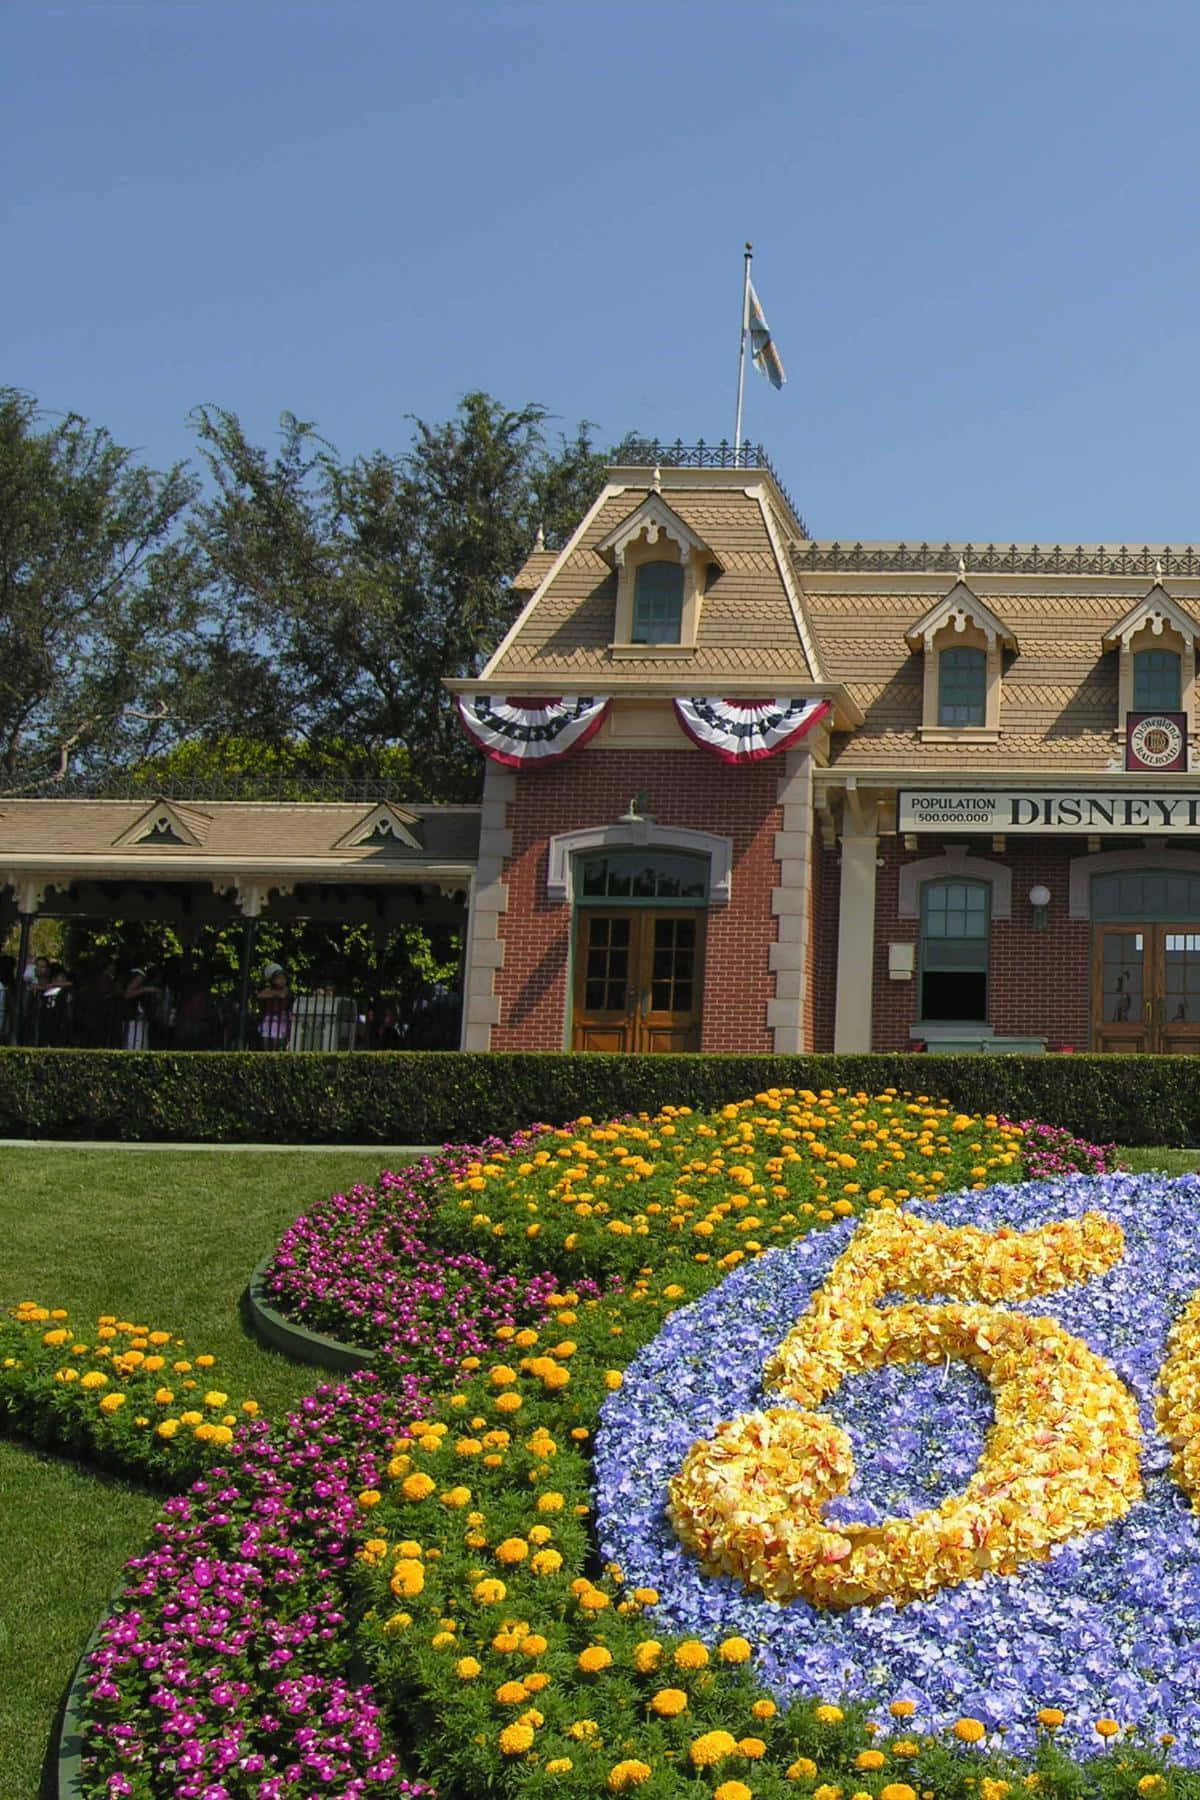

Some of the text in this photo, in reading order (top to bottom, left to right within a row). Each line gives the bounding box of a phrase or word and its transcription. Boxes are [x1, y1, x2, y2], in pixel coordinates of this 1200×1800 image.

[1134, 719, 1180, 740] Disneyland
[1135, 746, 1178, 764] RAILROAD
[911, 798, 996, 810] POPULATION
